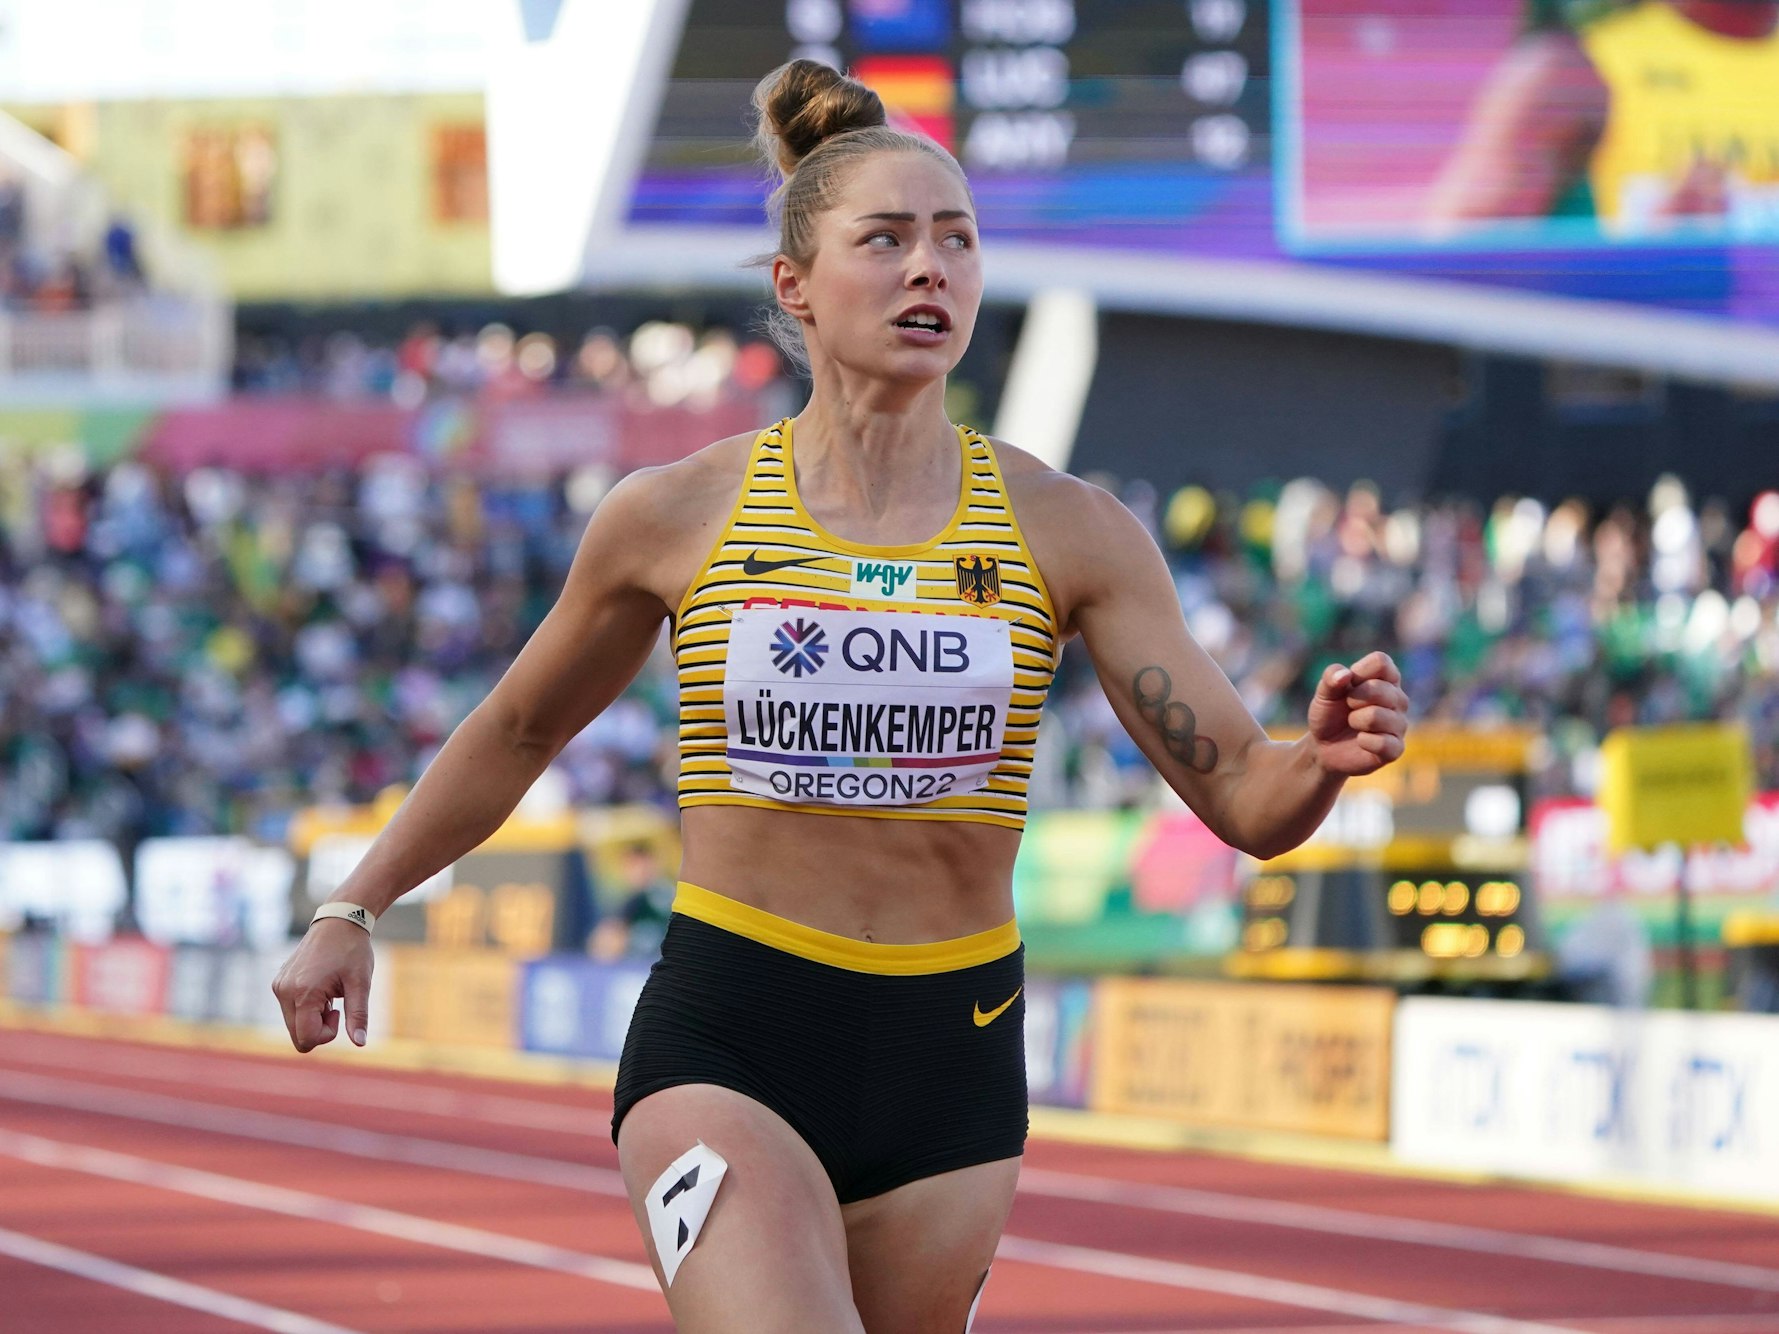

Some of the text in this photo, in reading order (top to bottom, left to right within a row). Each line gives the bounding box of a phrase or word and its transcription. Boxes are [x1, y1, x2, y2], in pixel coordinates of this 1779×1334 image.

[842, 627, 970, 673] QNB
[737, 689, 996, 753] LÜCKENKEMPER
[769, 770, 956, 799] OREGON22
[348, 913, 367, 925] adidas
